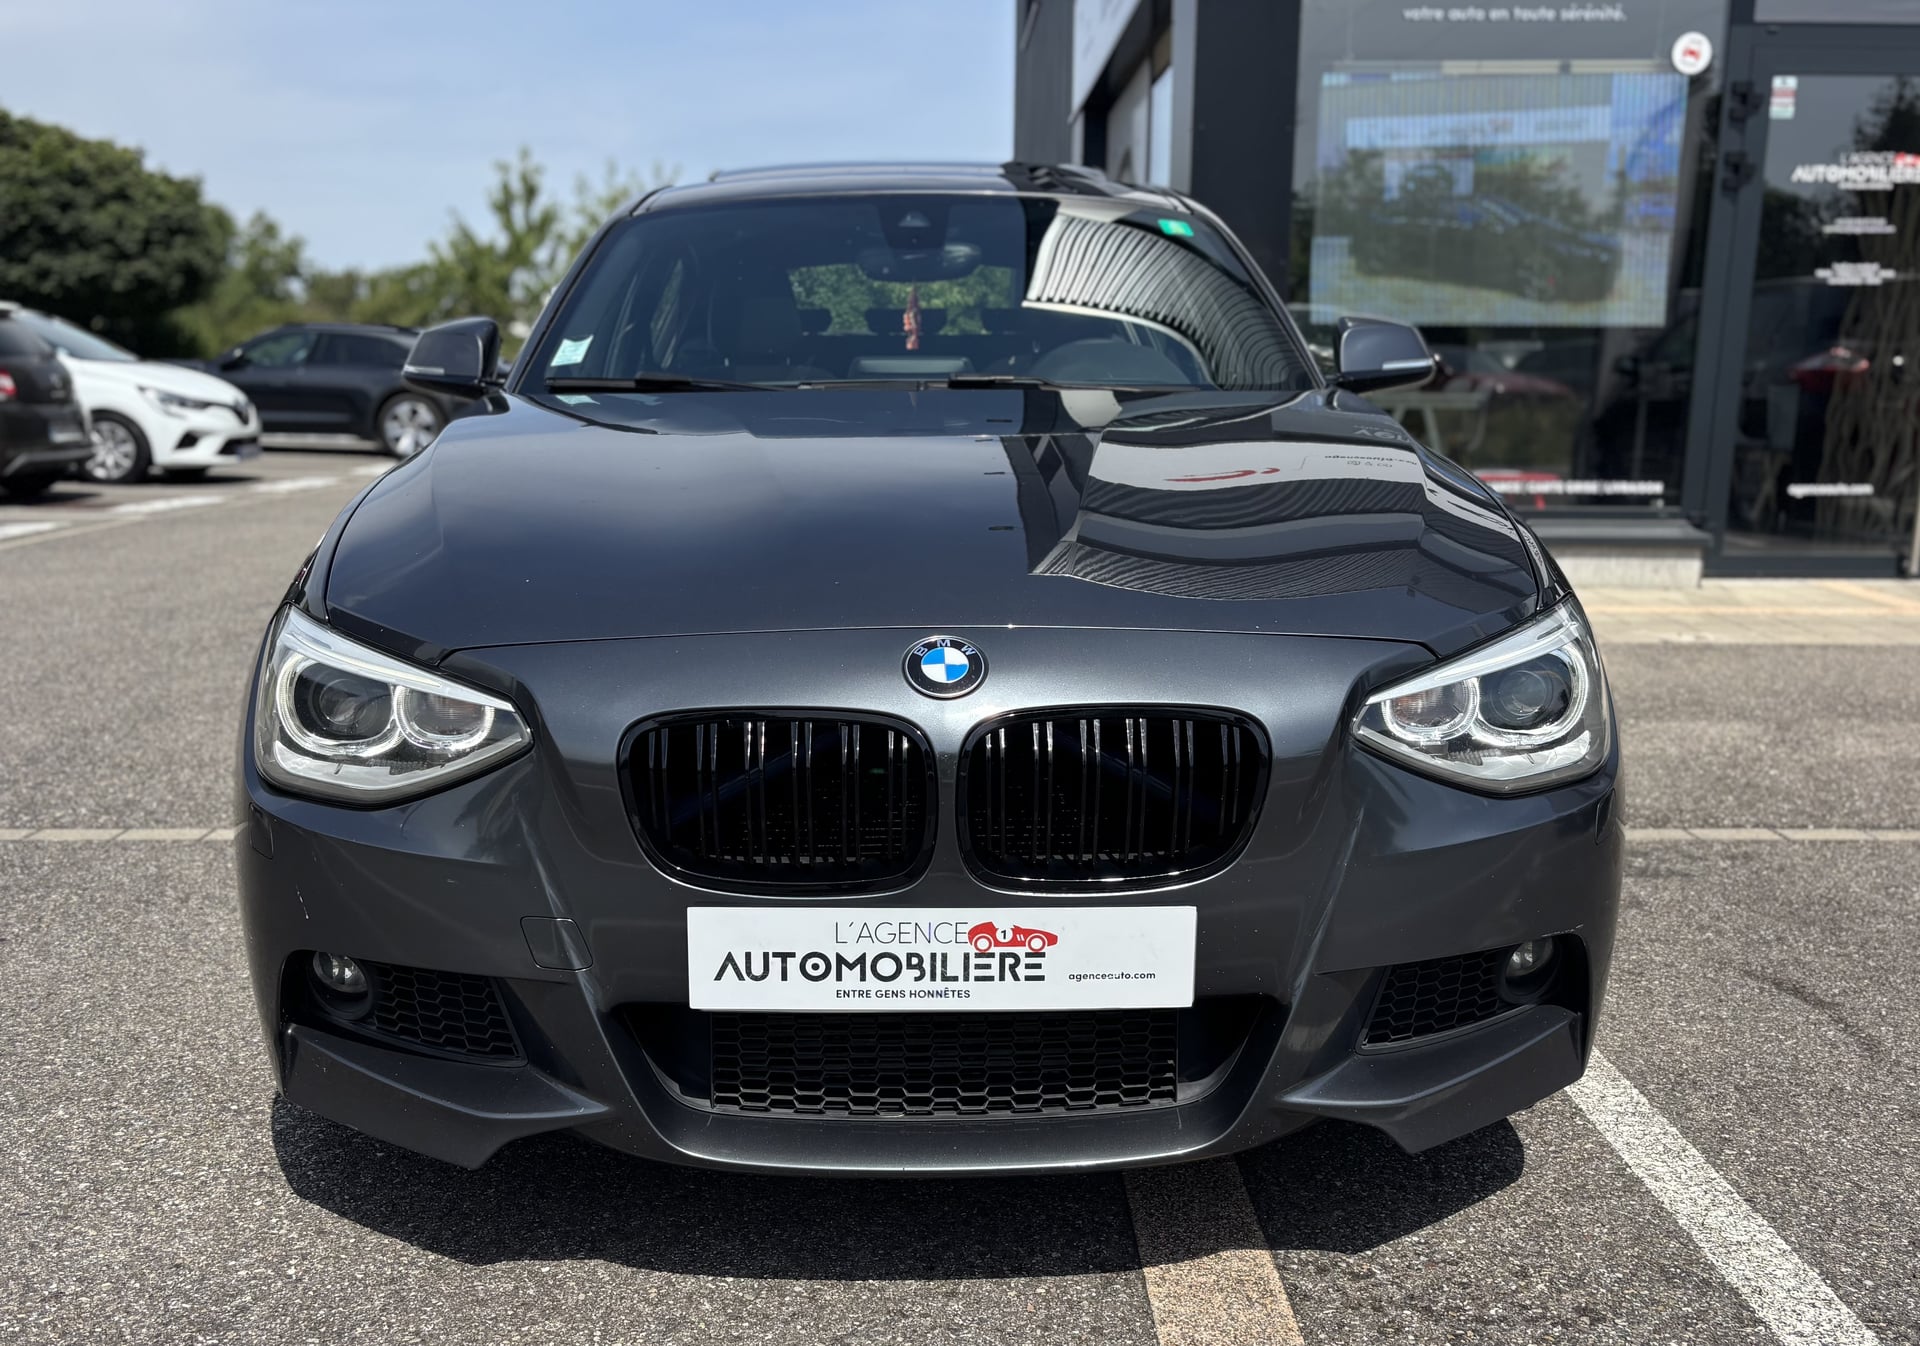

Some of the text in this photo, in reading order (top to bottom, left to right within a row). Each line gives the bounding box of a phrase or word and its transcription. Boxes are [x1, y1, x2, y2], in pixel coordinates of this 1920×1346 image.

[1403, 5, 1445, 20] votre
[1448, 5, 1486, 21] auto
[1489, 8, 1510, 21] en
[1513, 6, 1556, 21] toute
[913, 639, 976, 657] BMW
[835, 921, 969, 944] L'AGENCE
[1000, 929, 1007, 940] 1
[1068, 970, 1156, 983] agenceauto.com
[836, 987, 971, 999] ENTRE GENS HONNÊTES
